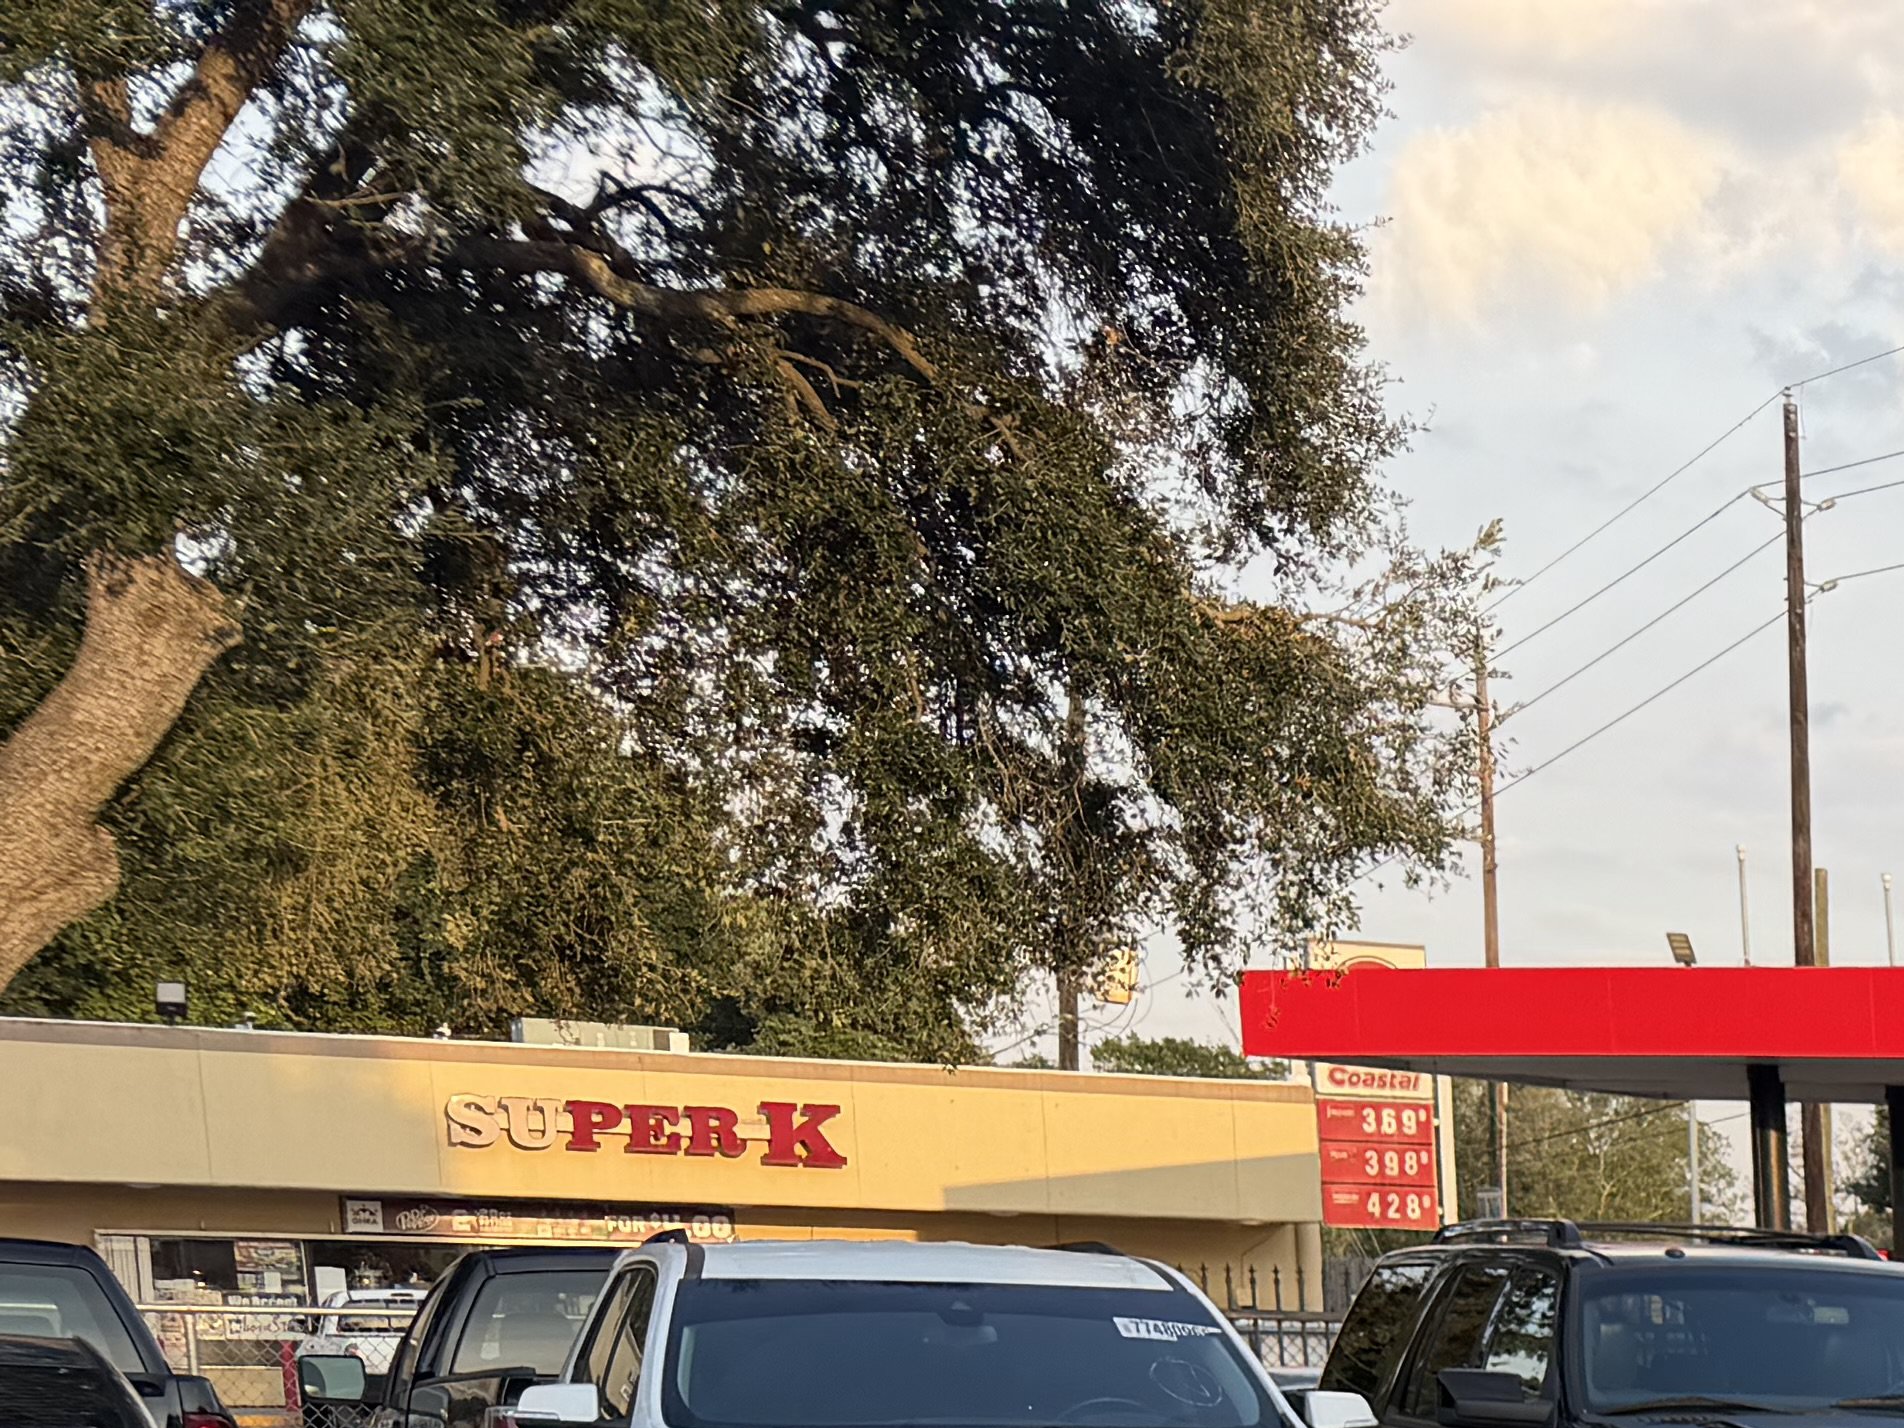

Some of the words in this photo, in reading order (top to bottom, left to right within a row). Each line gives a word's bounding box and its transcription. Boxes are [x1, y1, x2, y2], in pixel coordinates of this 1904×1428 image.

[1327, 1066, 1421, 1091] Coastal
[446, 1092, 746, 1159] SUPER
[756, 1101, 848, 1170] K
[604, 1214, 646, 1234] FOR
